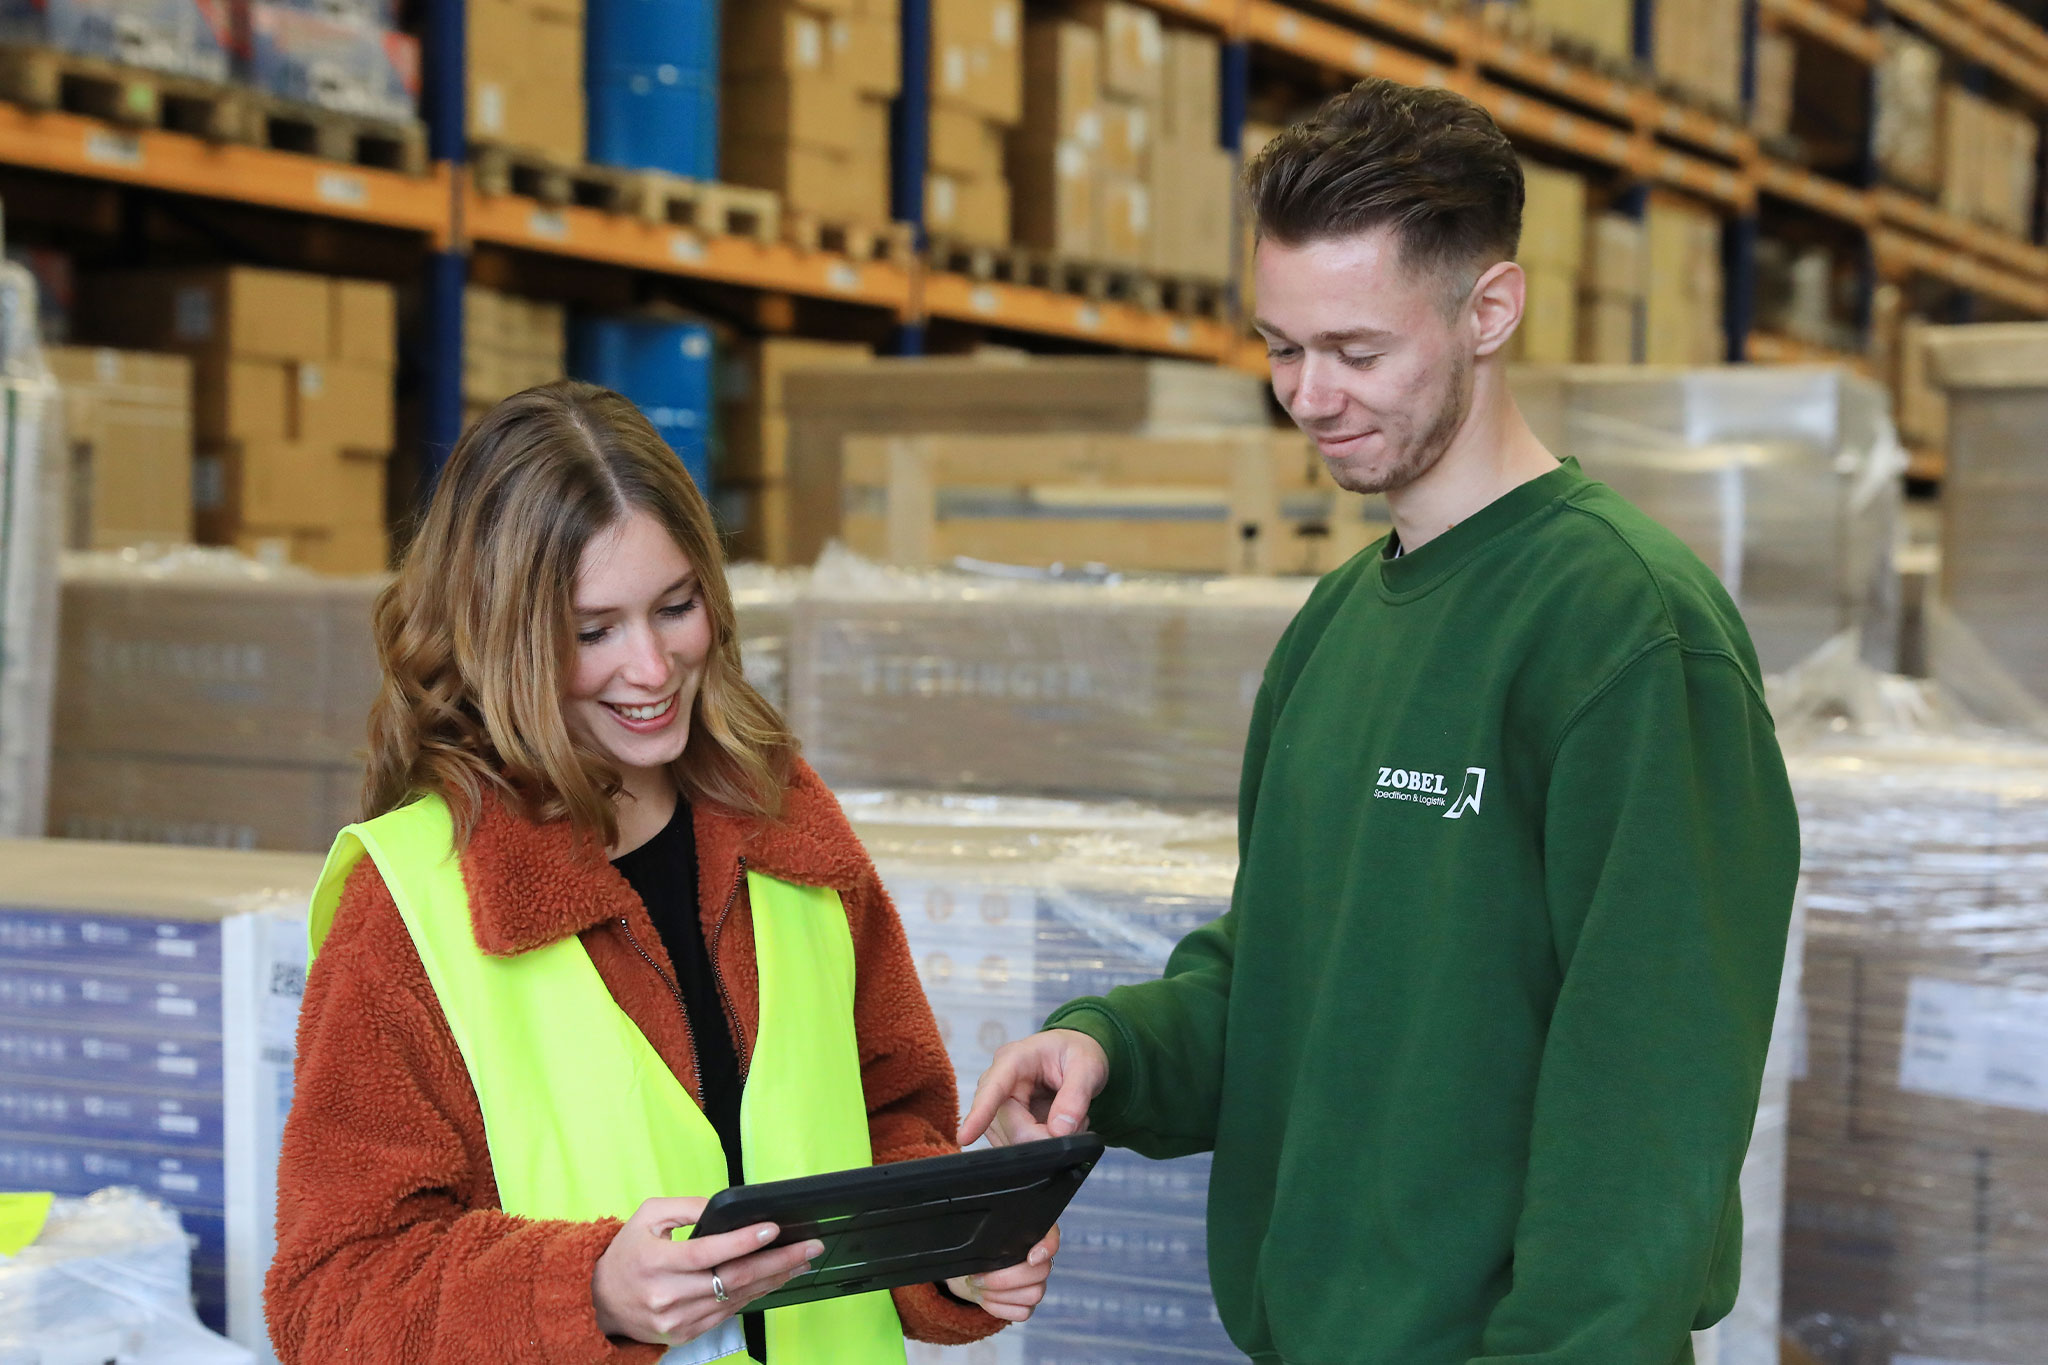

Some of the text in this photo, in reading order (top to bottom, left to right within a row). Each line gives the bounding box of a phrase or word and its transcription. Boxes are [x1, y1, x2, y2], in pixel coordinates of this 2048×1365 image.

[1376, 767, 1448, 795] ZOBEL
[1373, 788, 1446, 806] Spedition & Logistik
